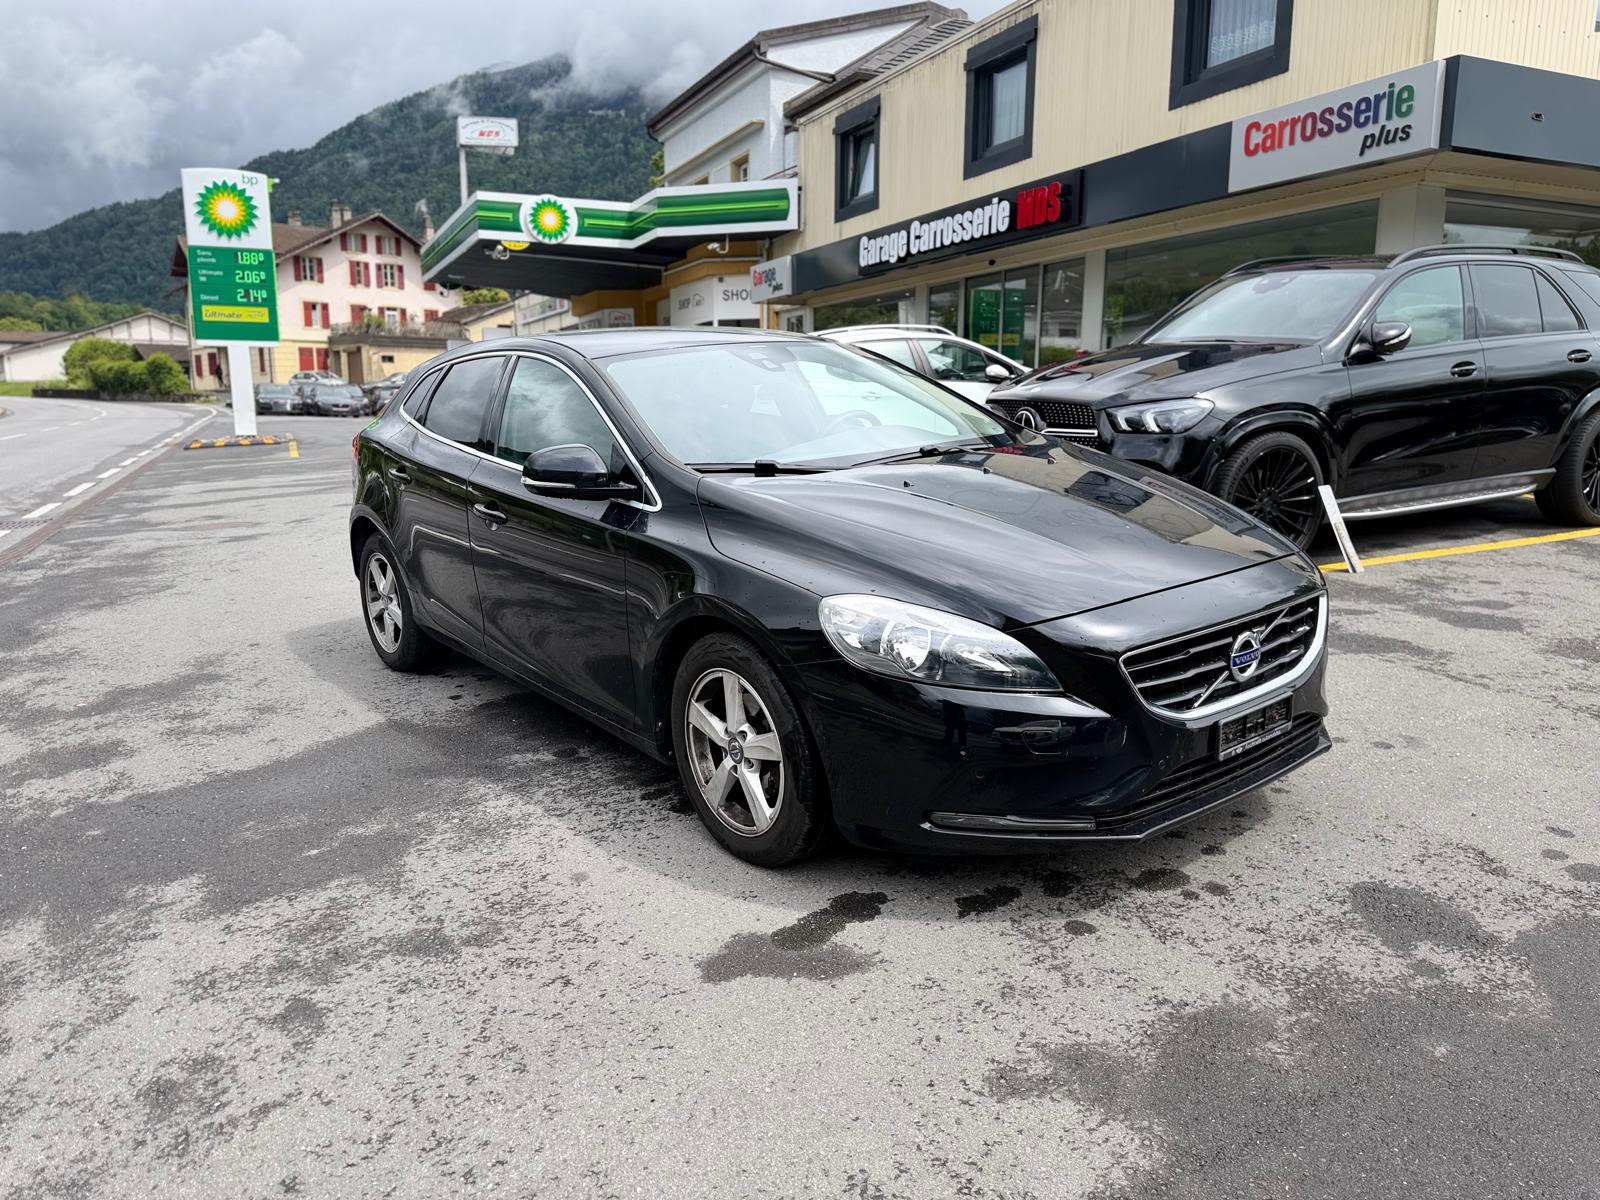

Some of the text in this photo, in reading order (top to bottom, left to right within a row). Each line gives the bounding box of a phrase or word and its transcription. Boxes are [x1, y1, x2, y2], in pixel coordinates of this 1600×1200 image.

[1243, 82, 1415, 157] Carrosserie
[1359, 124, 1412, 156] plus
[242, 174, 258, 186] bp
[859, 181, 1062, 268] Garage Carrosserie MDS
[753, 267, 776, 287] Garage
[1234, 650, 1260, 665] VOLVO
